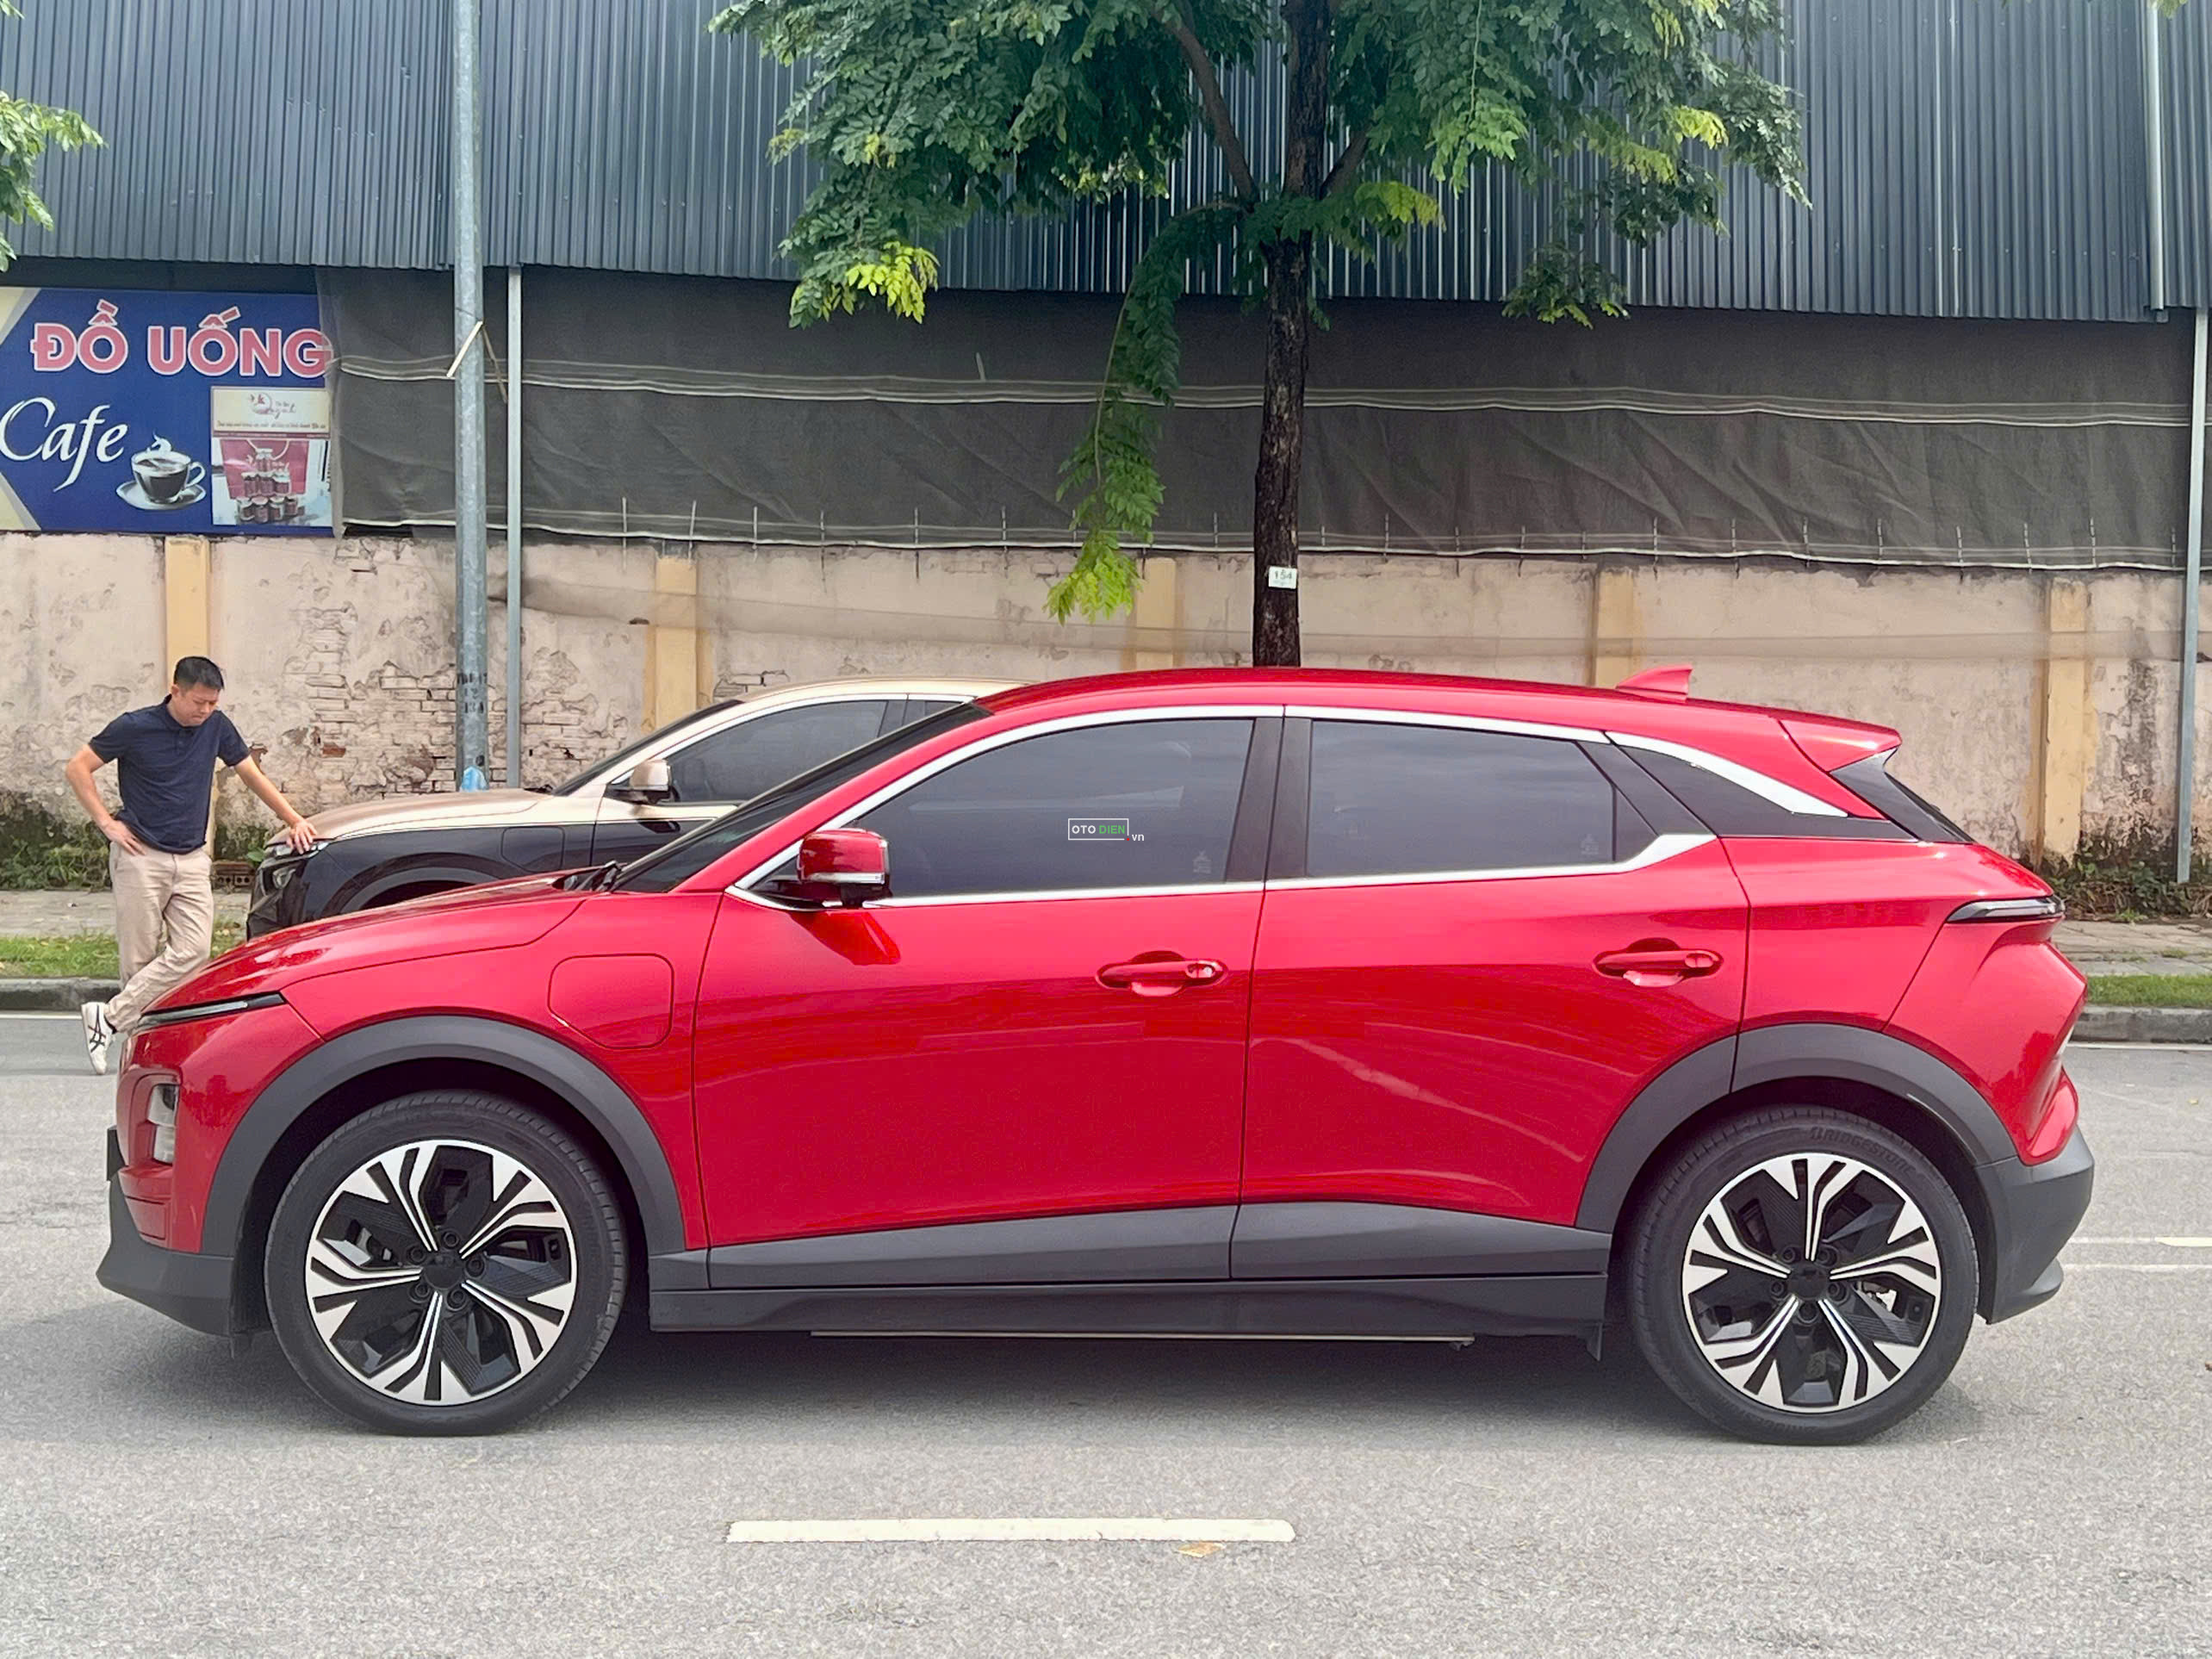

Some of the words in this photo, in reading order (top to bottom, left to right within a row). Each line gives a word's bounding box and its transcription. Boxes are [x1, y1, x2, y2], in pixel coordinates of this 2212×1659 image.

[30, 299, 128, 374] ĐỒ
[147, 306, 334, 378] UỐNG
[0, 396, 128, 493] Cafe
